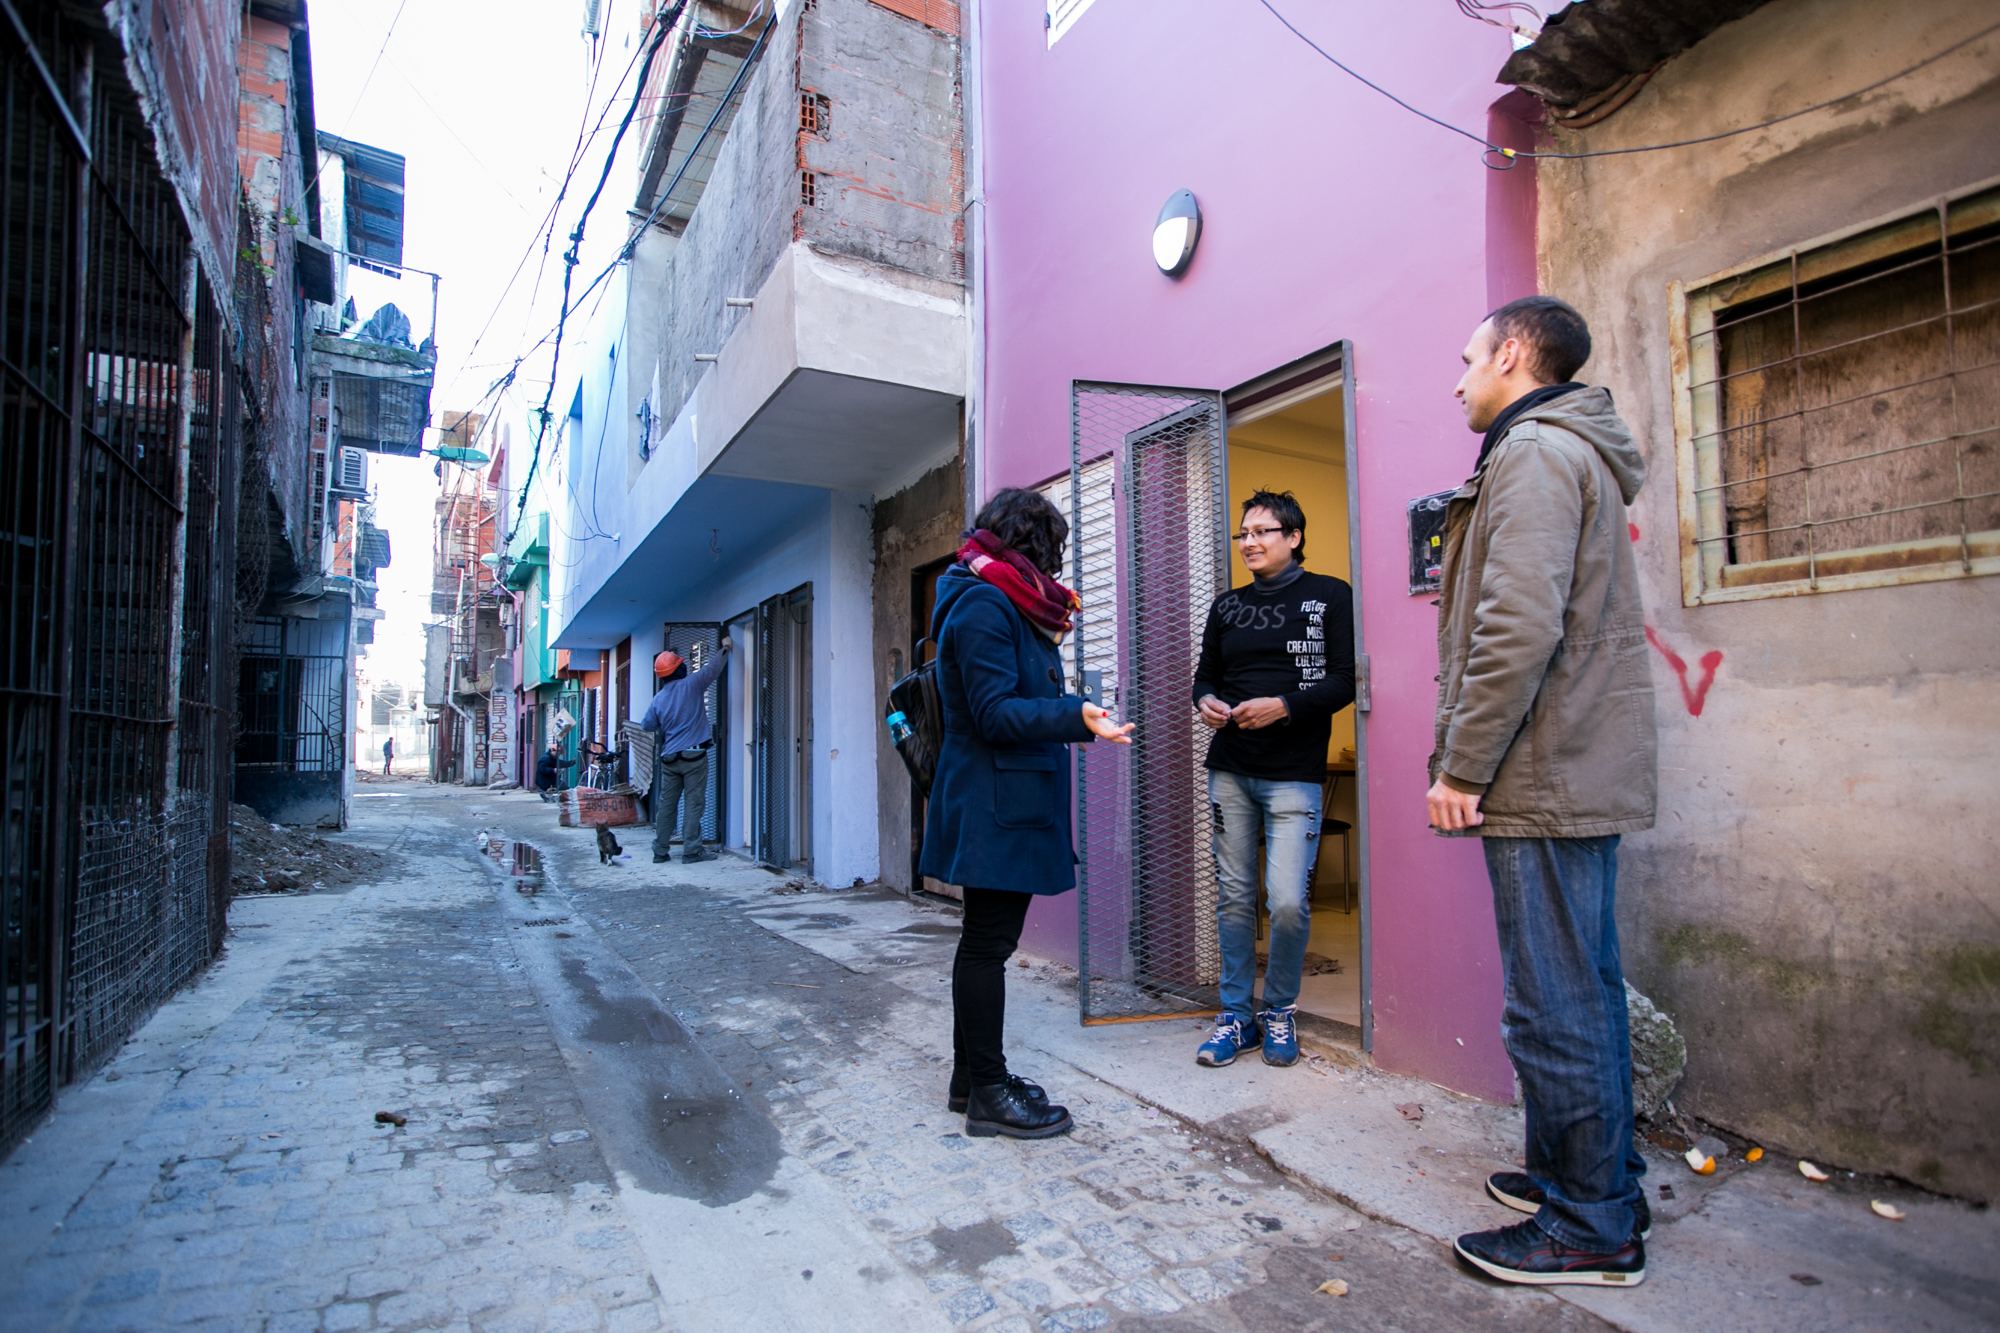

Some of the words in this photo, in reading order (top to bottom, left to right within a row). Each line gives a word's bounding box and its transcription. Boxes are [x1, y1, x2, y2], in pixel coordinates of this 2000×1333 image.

[1287, 640, 1326, 653] CREATIVIT
[492, 696, 508, 742] BEBIDAS
[475, 709, 486, 769] BEBIDAS
[491, 749, 508, 778] FRIA
